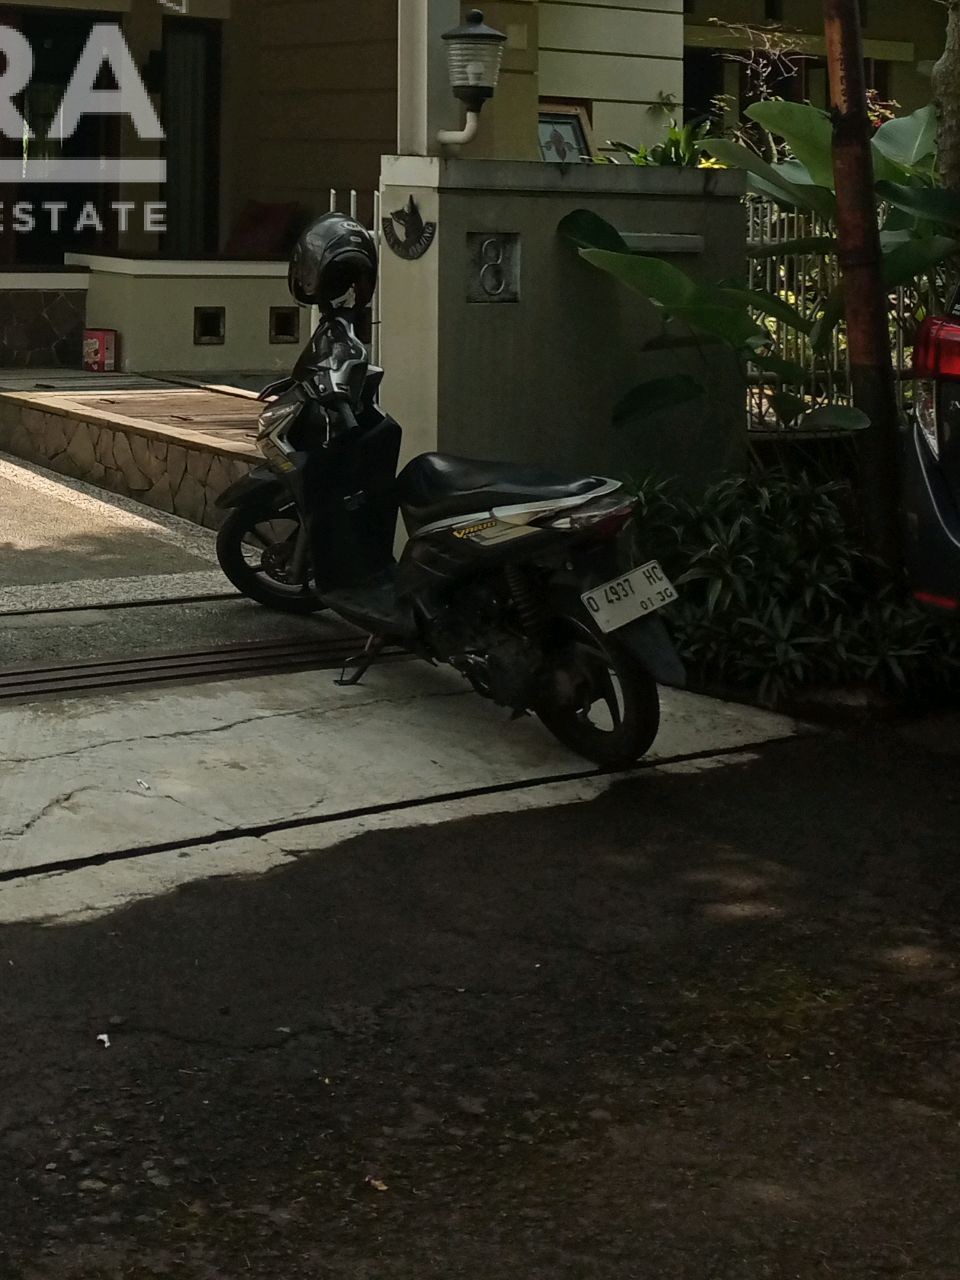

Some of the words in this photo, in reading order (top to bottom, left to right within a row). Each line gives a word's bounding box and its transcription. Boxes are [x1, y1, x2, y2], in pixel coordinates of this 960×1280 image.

[480, 238, 505, 297] 8
[603, 578, 636, 604] 4937
[642, 565, 664, 586] HC
